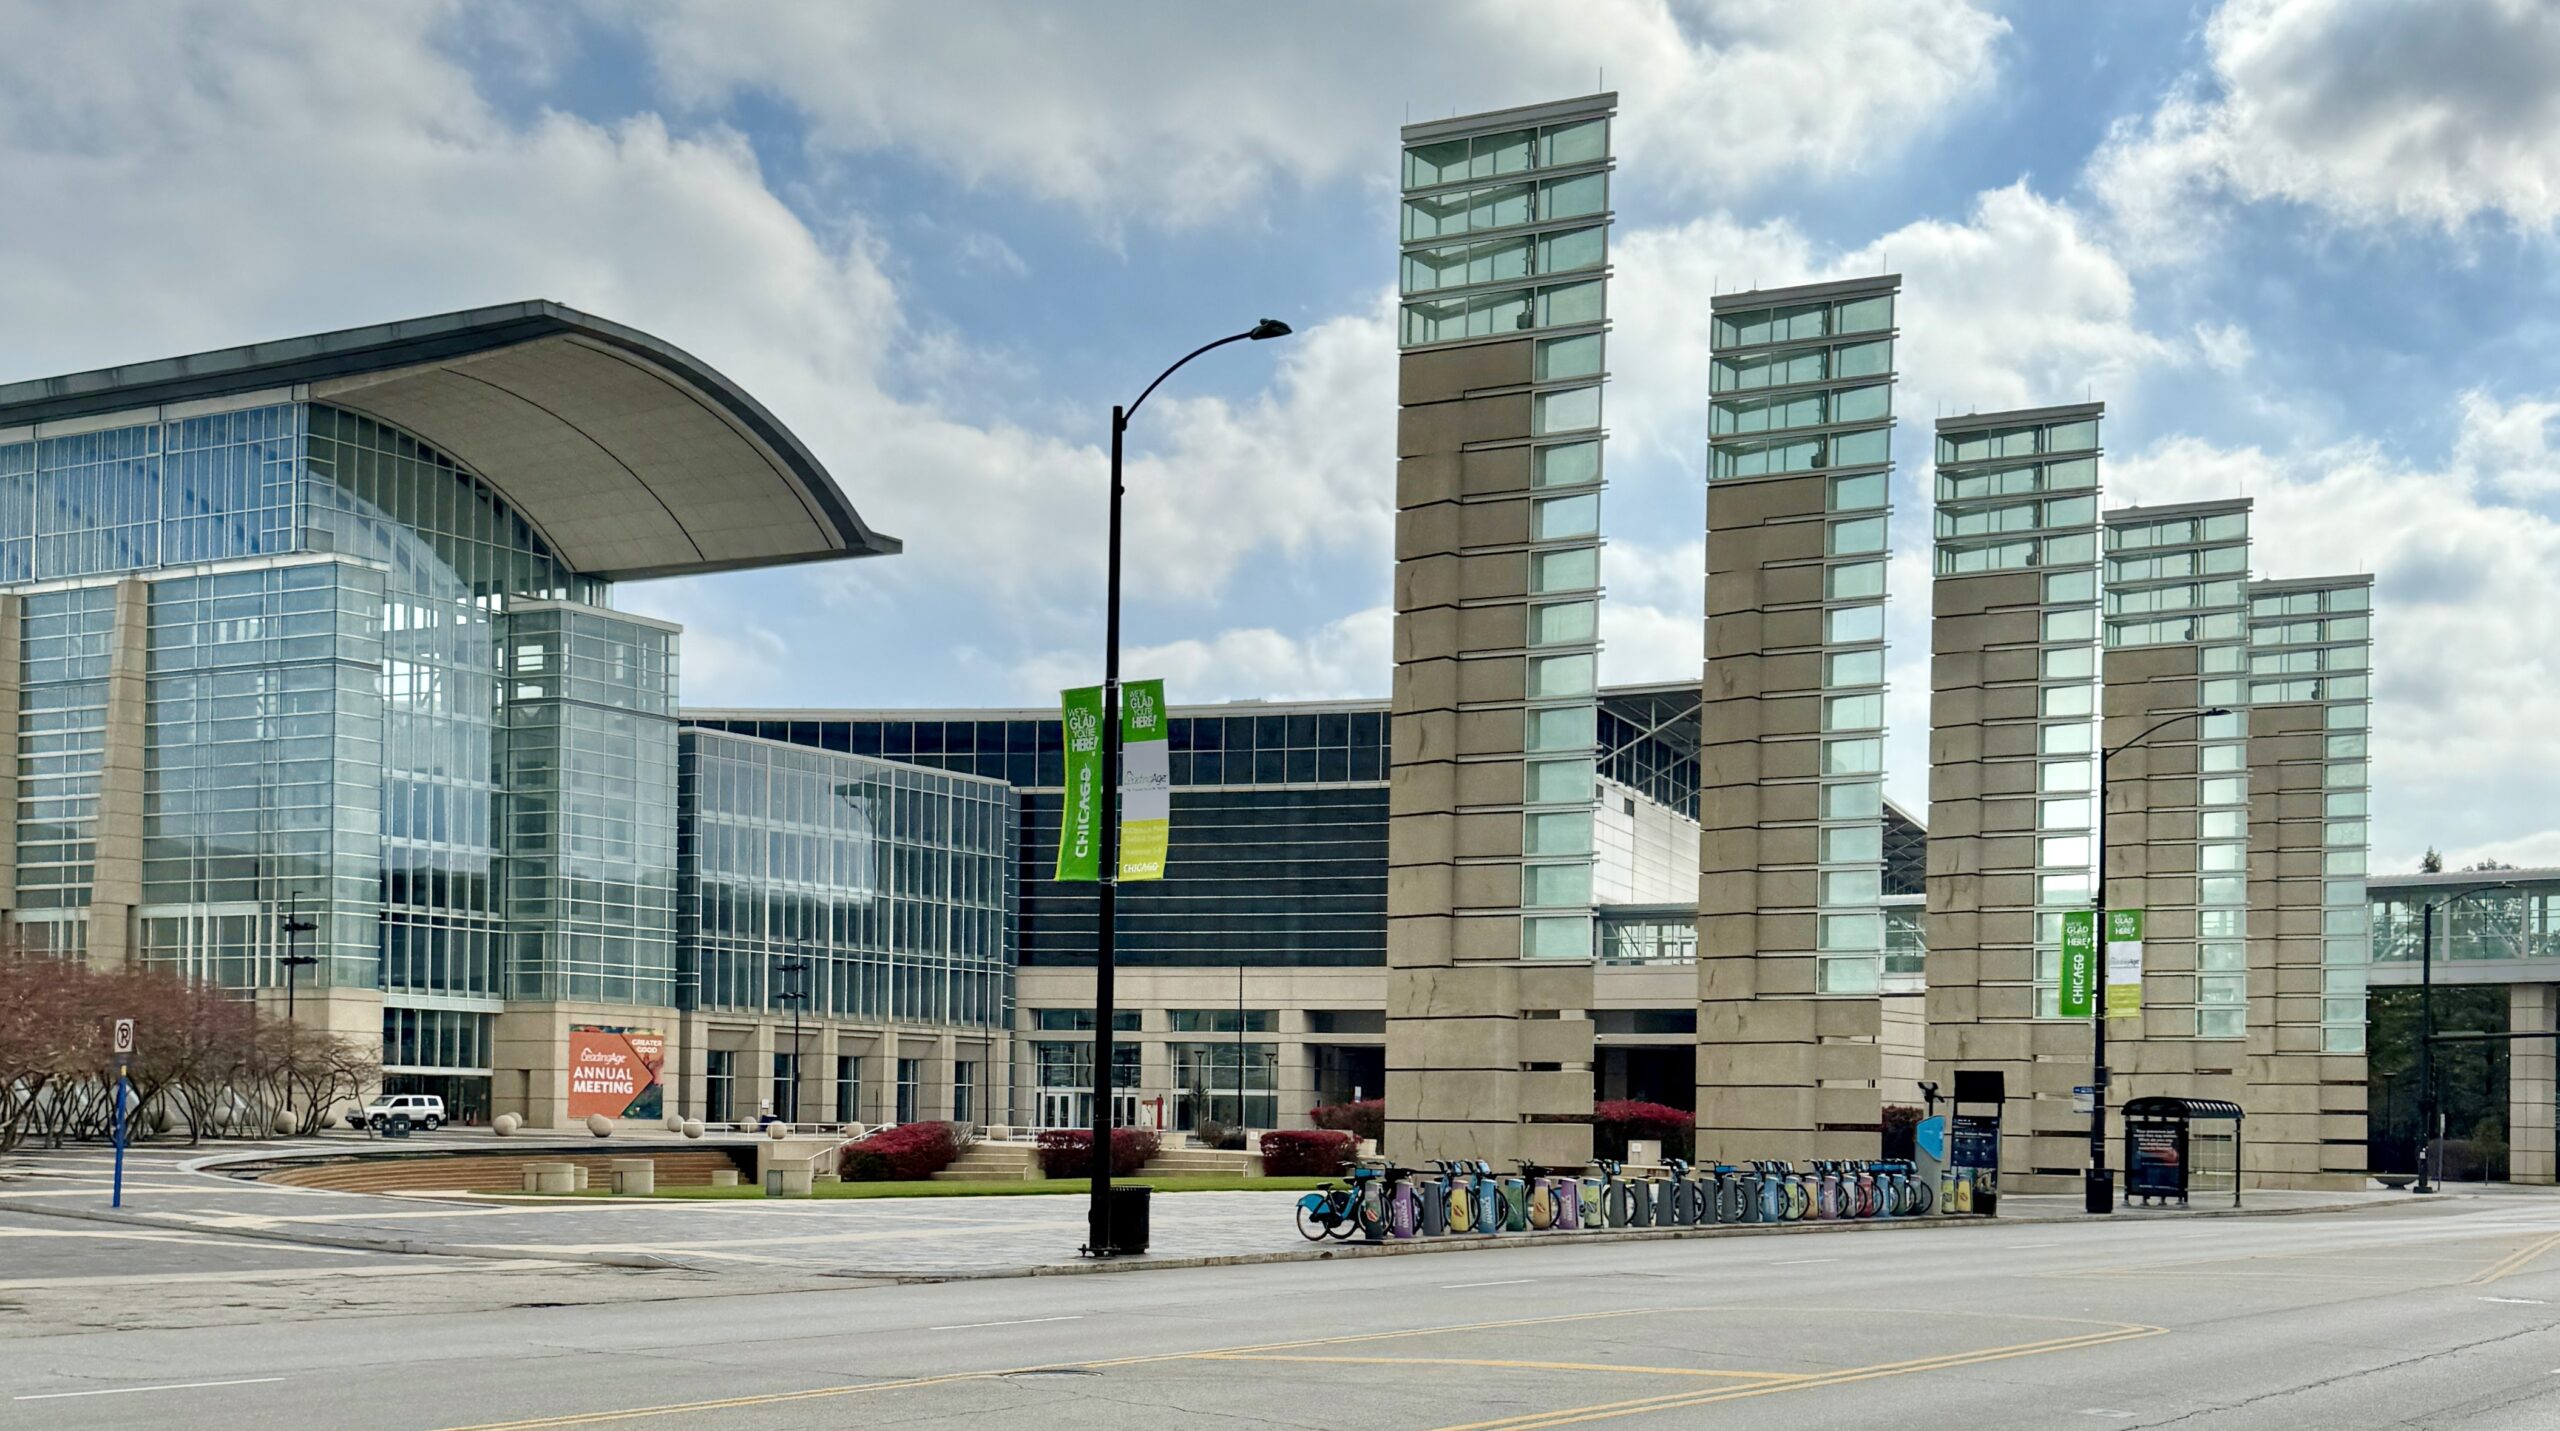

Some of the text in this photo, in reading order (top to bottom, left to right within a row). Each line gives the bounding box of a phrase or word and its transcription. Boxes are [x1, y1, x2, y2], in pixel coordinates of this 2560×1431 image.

[1130, 695, 1153, 709] GLAD
[1069, 715, 1096, 730] GLAD
[1132, 715, 1157, 732] HERE!
[1072, 736, 1098, 756] HERE!
[1075, 764, 1092, 858] CHICAGO
[1123, 862, 1159, 873] CHICAGO
[2115, 917, 2134, 925] GLAD
[2067, 926, 2089, 934] GLAD
[2073, 953, 2085, 1004] CHICAGO
[632, 1039, 662, 1047] GREATER
[573, 1066, 633, 1080] ANNUAL
[573, 1080, 633, 1094] MEETING
